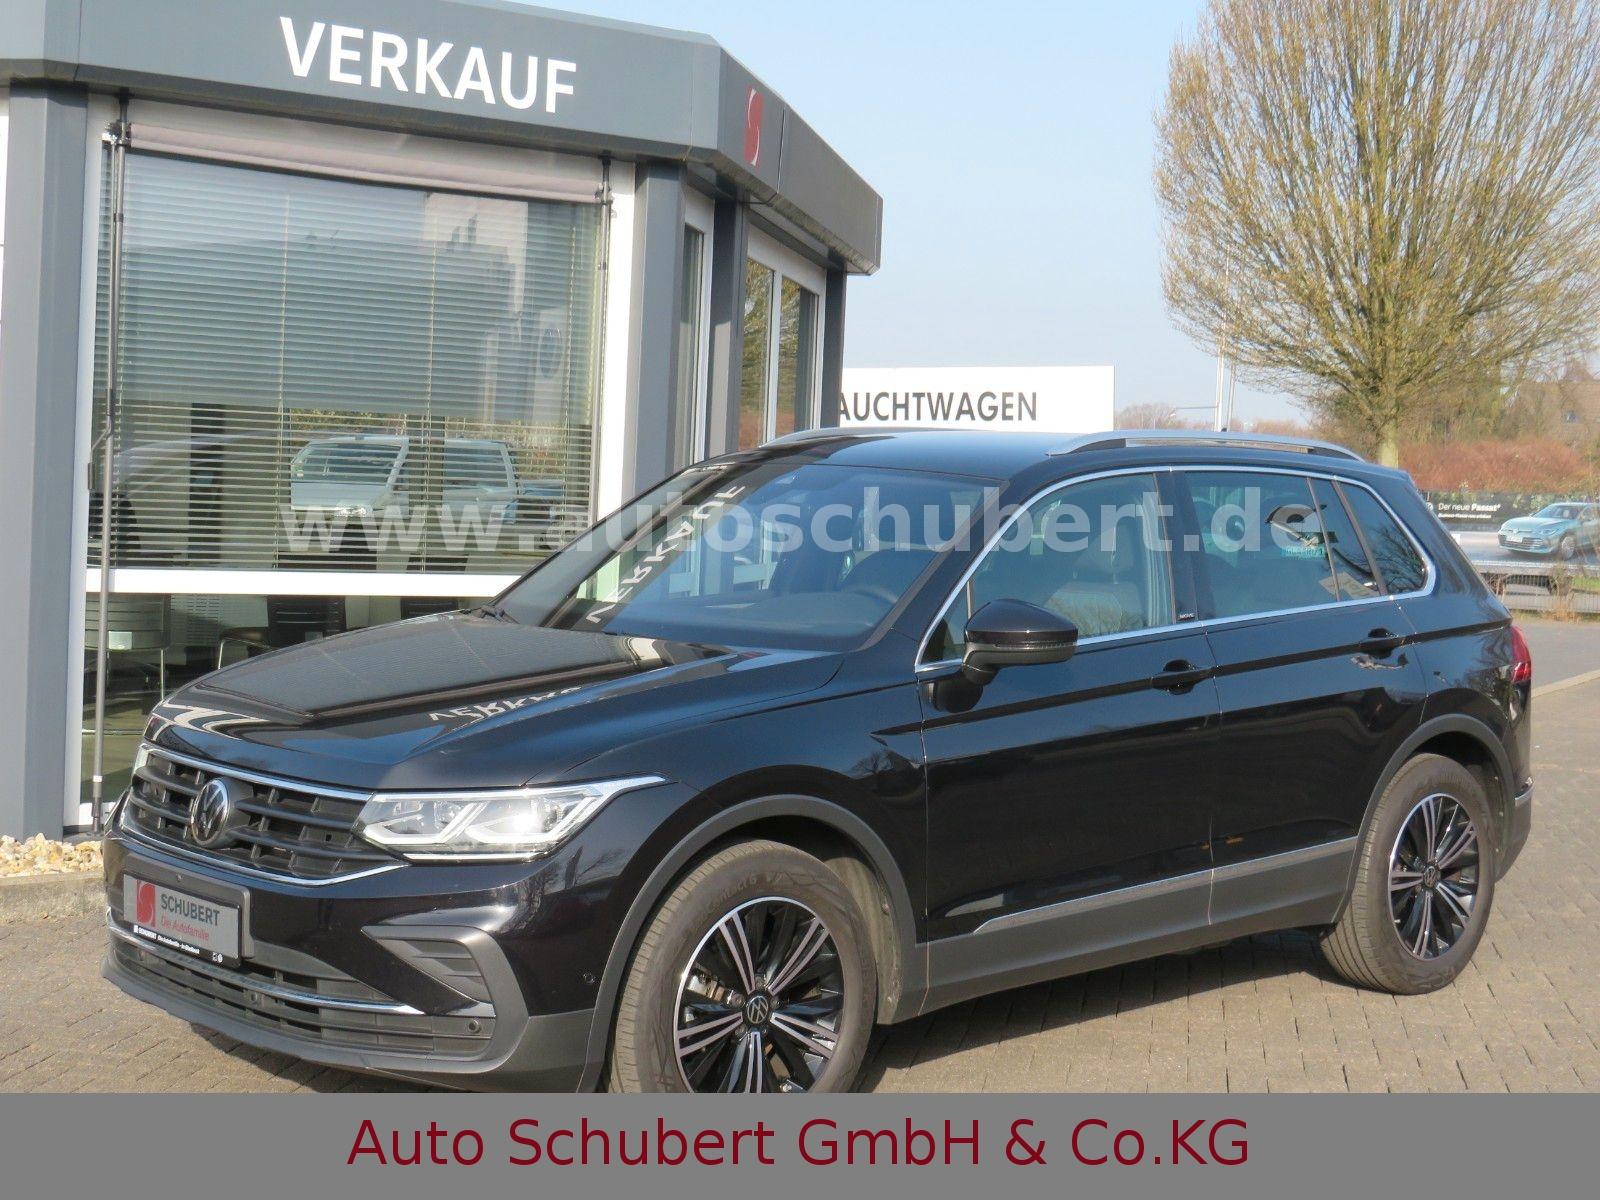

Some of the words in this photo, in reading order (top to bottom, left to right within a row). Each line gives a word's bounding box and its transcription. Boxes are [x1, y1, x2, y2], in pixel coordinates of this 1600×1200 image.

[280, 16, 577, 113] VERKAUF
[1438, 503, 1450, 511] Der
[160, 893, 220, 926] SCHUBERT
